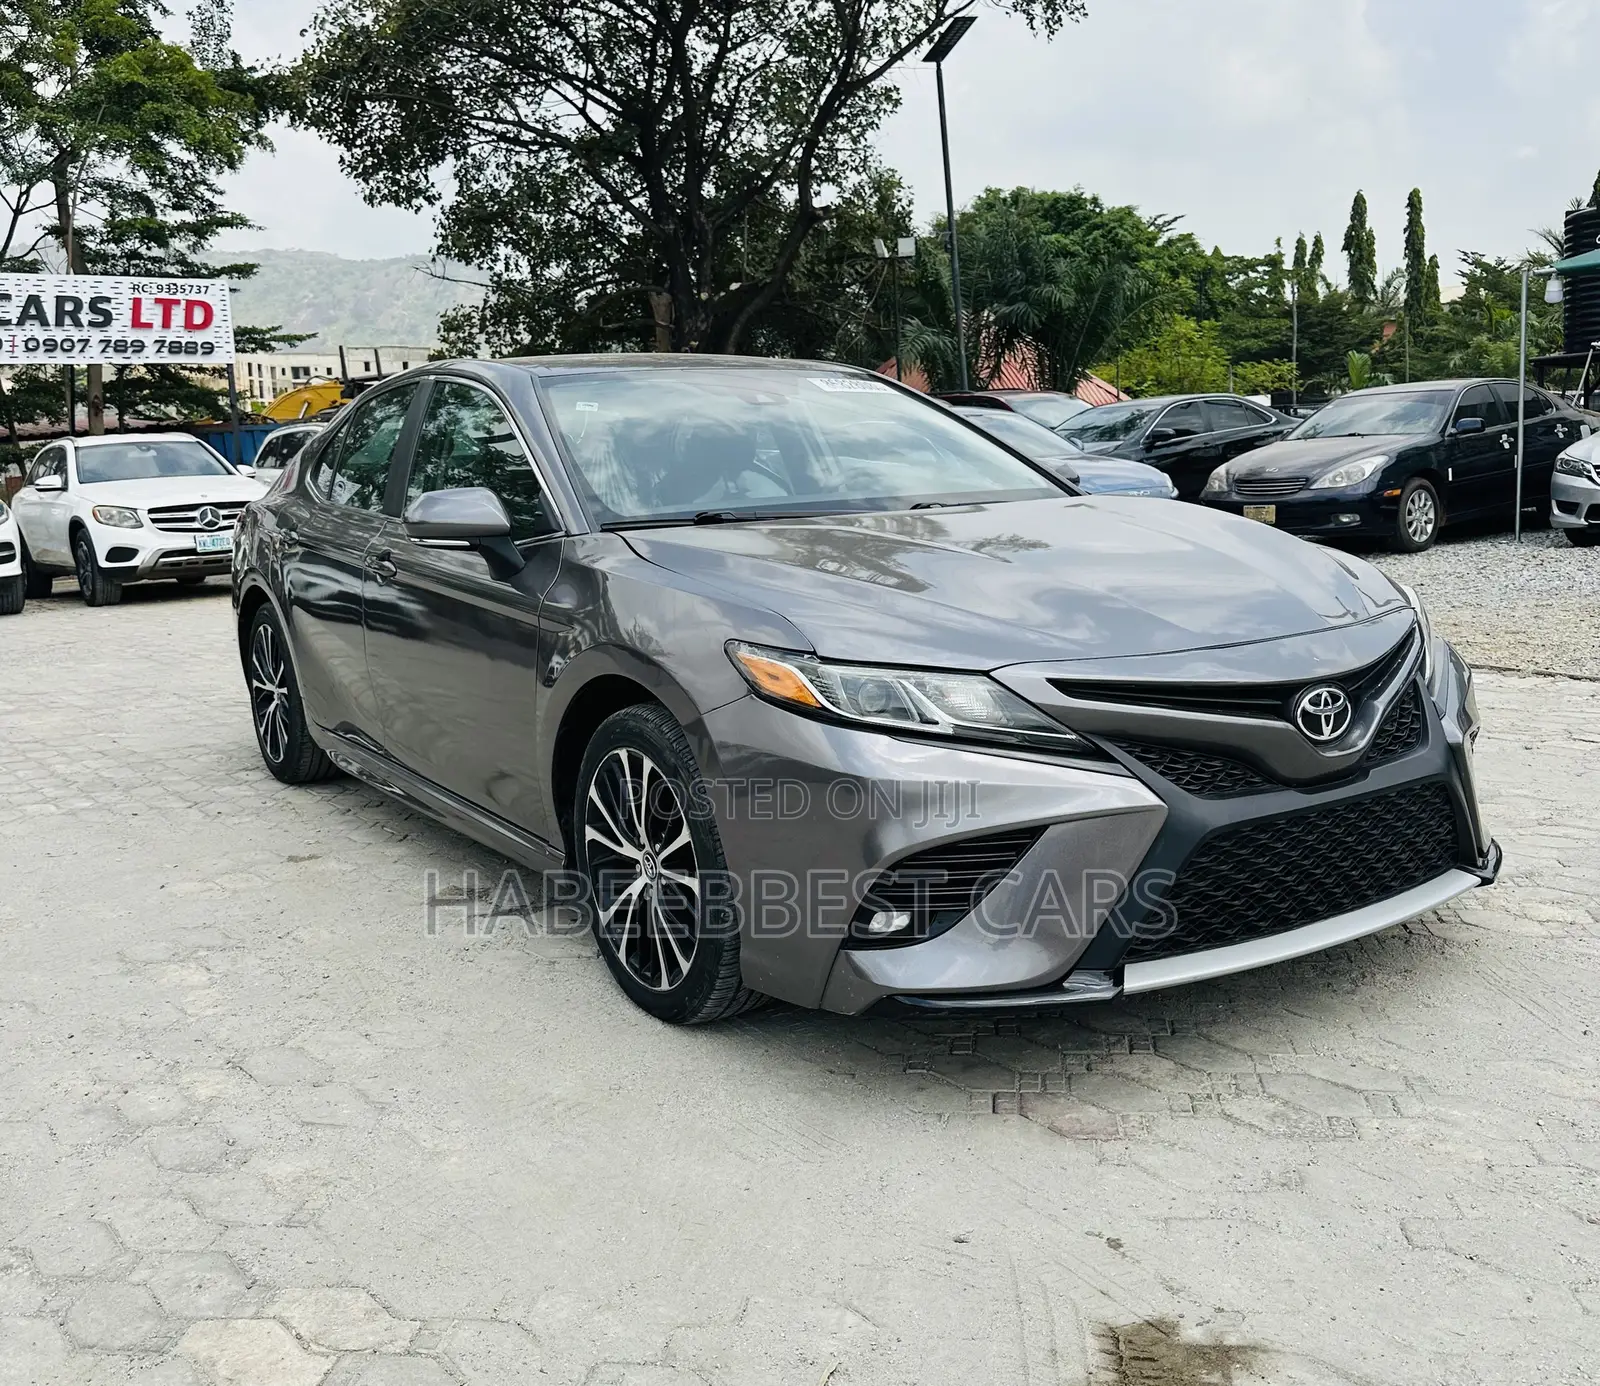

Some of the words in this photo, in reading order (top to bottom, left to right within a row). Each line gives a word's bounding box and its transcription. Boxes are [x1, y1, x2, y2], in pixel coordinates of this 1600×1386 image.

[156, 284, 209, 295] 9335737
[131, 297, 214, 331] LTD
[24, 337, 91, 353] 0907
[98, 339, 146, 353] 789
[153, 339, 215, 355] 7889
